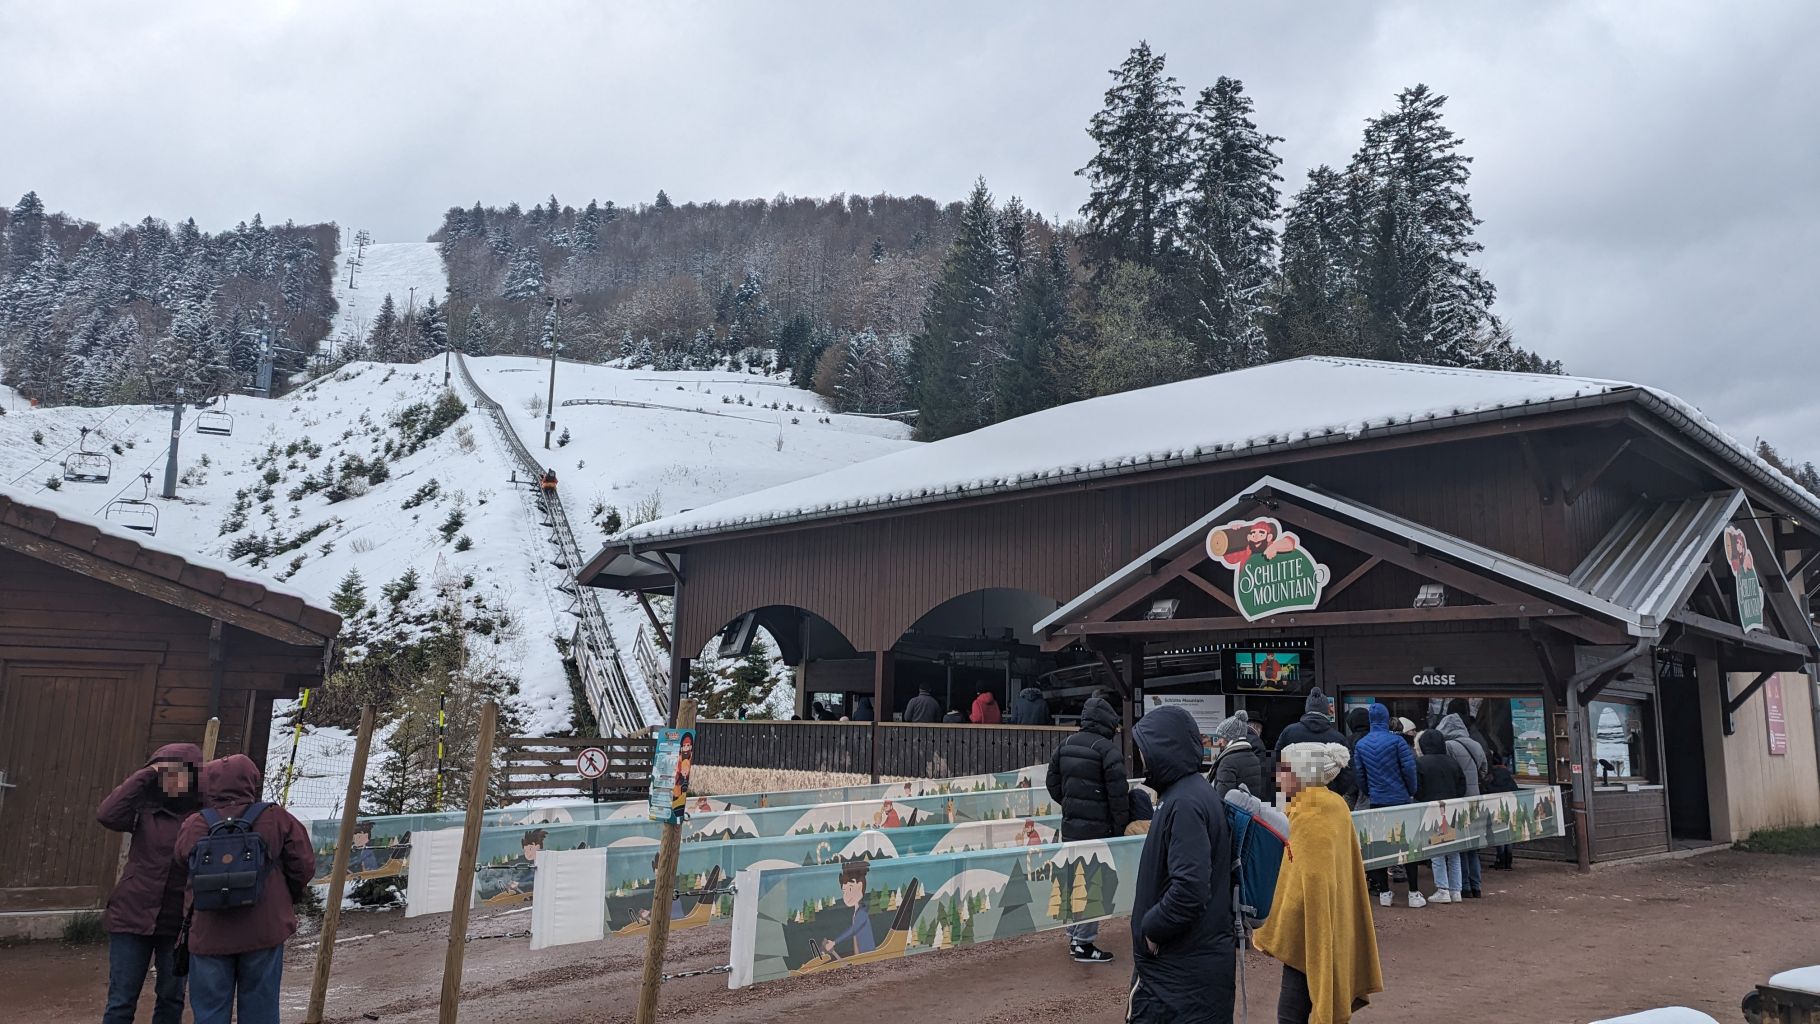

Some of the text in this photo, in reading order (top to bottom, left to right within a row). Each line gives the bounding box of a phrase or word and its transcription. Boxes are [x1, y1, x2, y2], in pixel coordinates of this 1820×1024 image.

[1240, 558, 1304, 593] SCHLITTE
[1253, 576, 1317, 607] MOUNTAIN
[1412, 674, 1456, 686] CAISSE
